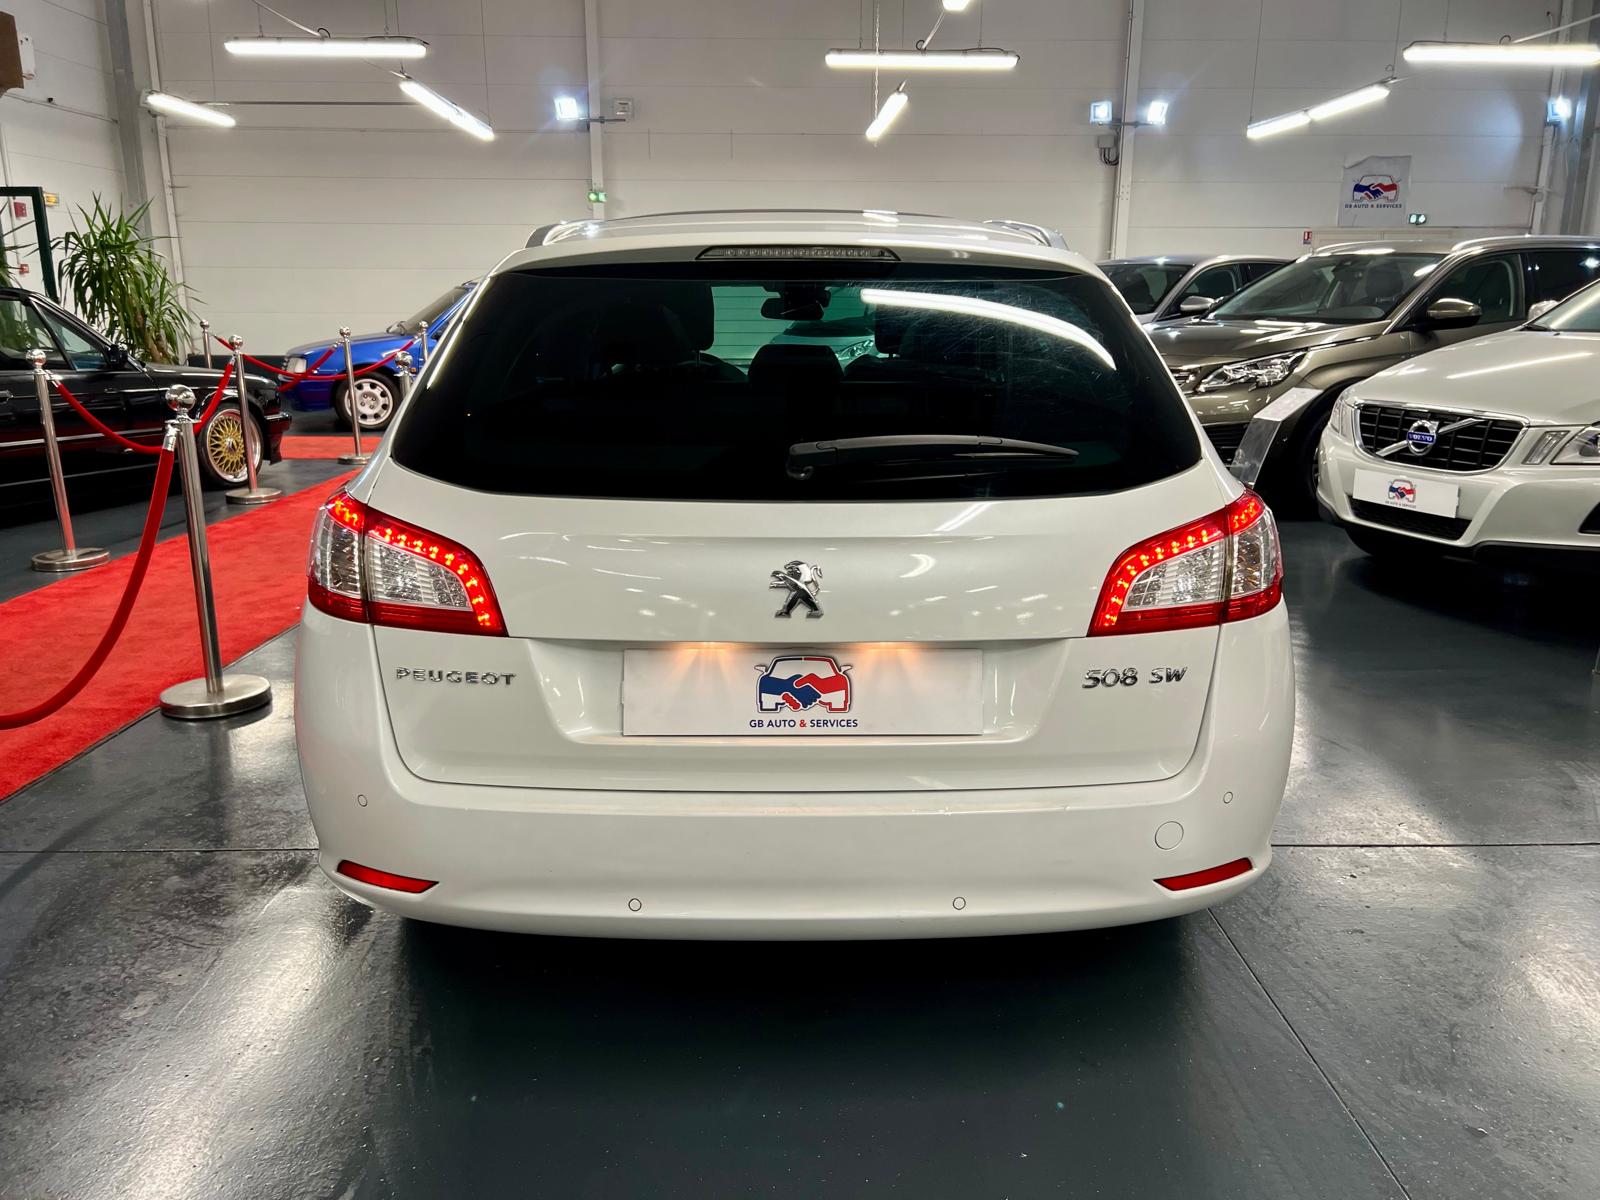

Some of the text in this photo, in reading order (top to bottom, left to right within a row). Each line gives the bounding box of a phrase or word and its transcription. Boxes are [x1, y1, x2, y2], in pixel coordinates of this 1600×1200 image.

[396, 667, 516, 686] PEUGEOT
[1082, 666, 1188, 689] 508 SW
[749, 719, 858, 728] GB AUTO & SERVICES
